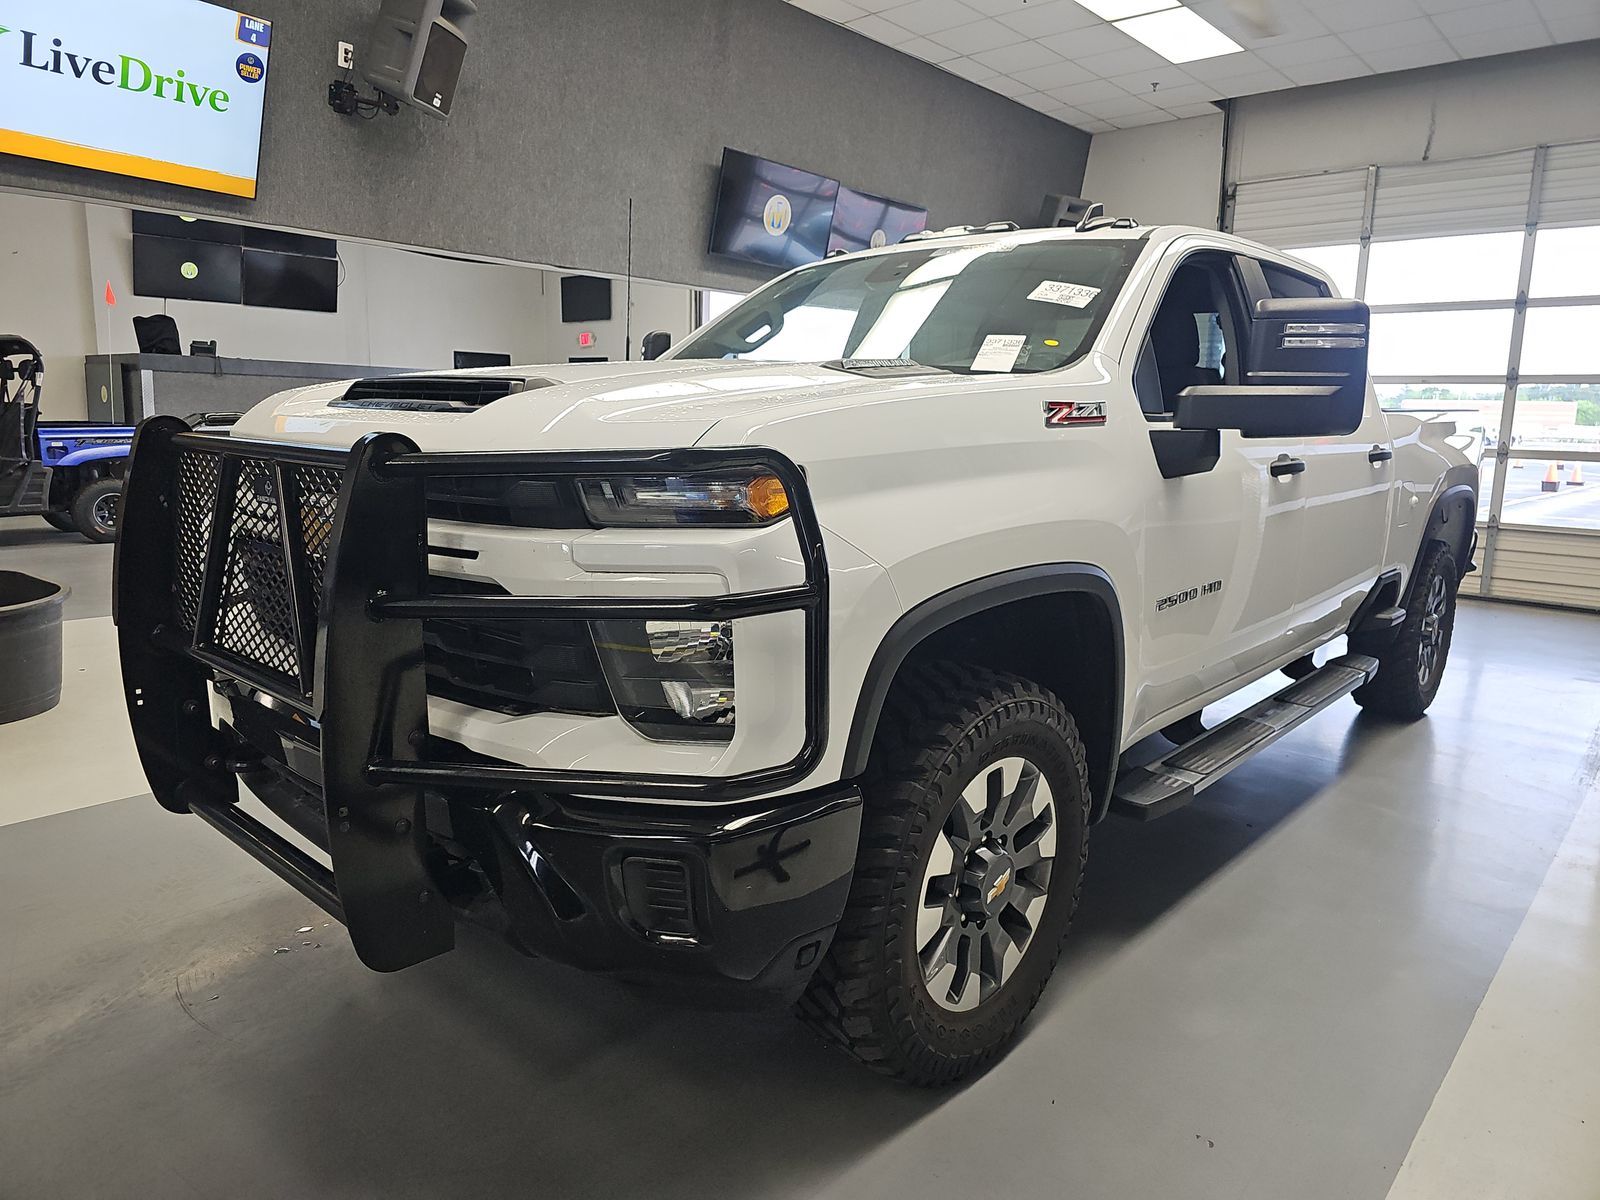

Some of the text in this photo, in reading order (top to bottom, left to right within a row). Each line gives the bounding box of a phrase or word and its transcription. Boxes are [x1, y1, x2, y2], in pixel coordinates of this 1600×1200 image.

[245, 18, 264, 32] LANE
[250, 33, 257, 43] 4
[19, 29, 230, 112] LiveDrive
[1155, 580, 1222, 612] 2500 HD
